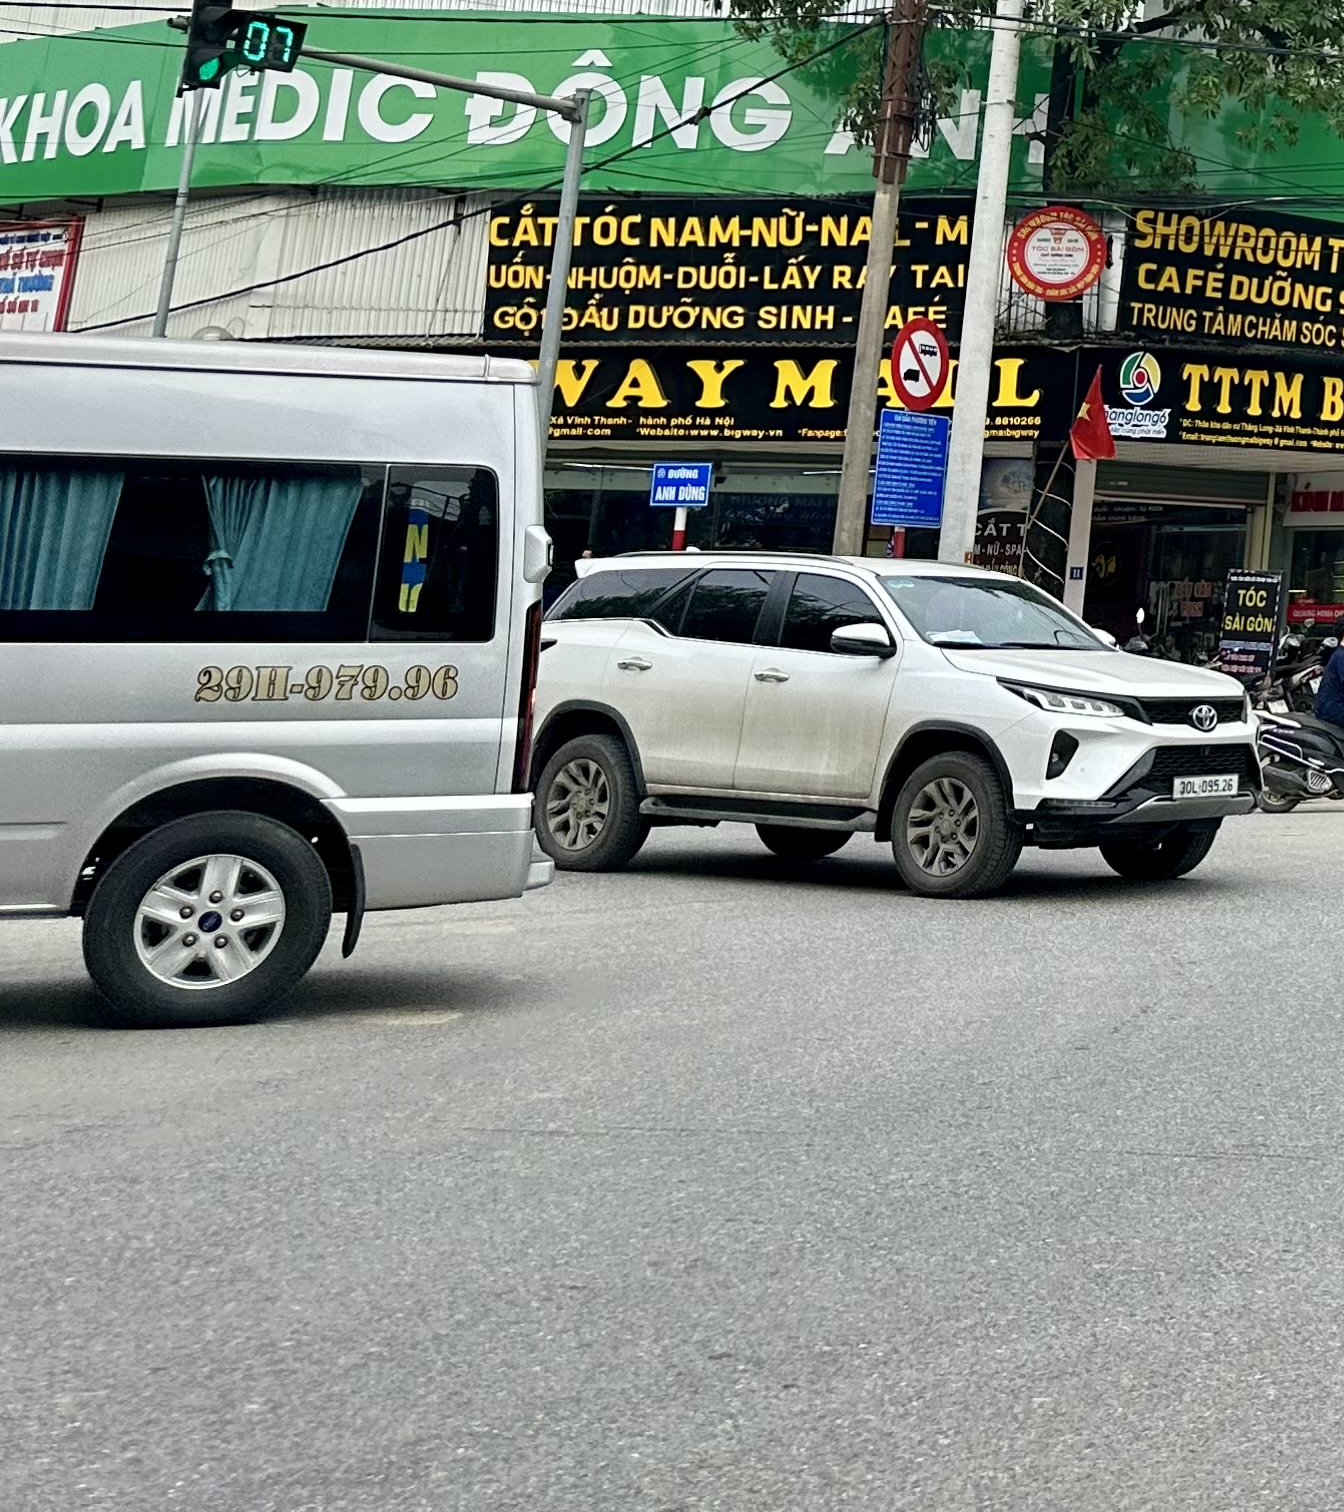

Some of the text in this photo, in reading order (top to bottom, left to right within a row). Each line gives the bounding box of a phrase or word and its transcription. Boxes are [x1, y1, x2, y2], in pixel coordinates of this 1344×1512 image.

[243, 21, 294, 63] 07
[0, 79, 146, 165] KHOA
[165, 67, 438, 148] MEDIC
[465, 49, 793, 152] ĐÔNG
[489, 203, 560, 247] CẮT
[572, 204, 642, 247] TÓC
[1134, 210, 1322, 271] SHOWROOM
[911, 264, 965, 288] TAI
[1138, 263, 1225, 298] CAFÉ
[1229, 270, 1333, 313] DƯỠNG
[560, 292, 619, 331] ĐẦU
[628, 297, 745, 329] DƯỠNG
[757, 305, 835, 329] SINH
[884, 294, 947, 329] AFÉ
[1130, 302, 1197, 332] TRUNG
[1202, 306, 1243, 337] TÂM
[1244, 313, 1297, 342] CHĂM
[1300, 316, 1337, 347] SÓC
[1182, 363, 1302, 419] TTTM
[696, 416, 711, 425] Hà
[667, 467, 698, 480] ĐƯỜNG
[655, 486, 675, 501] ANH
[1291, 482, 1329, 512] KÍNH
[1237, 585, 1267, 608] TÓC
[1224, 614, 1273, 632] SÀI GÒN
[195, 664, 459, 702] 29H-979.96
